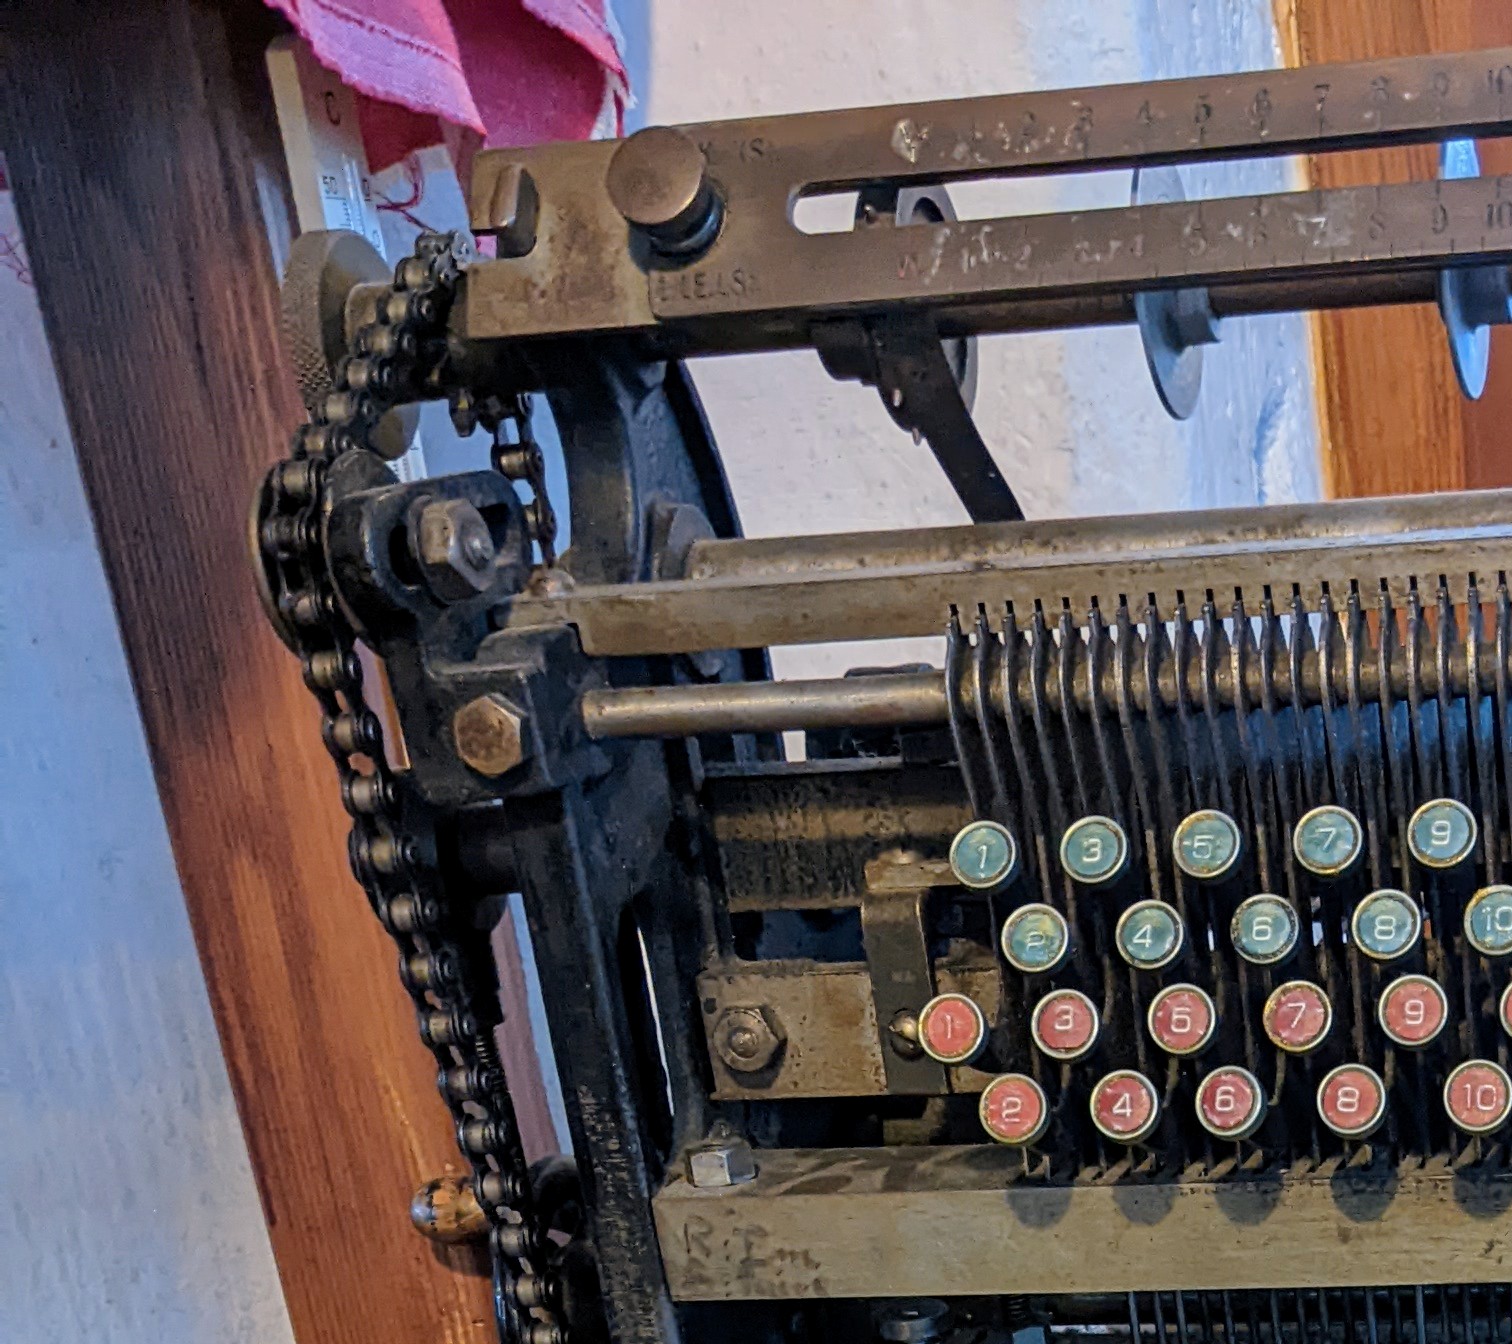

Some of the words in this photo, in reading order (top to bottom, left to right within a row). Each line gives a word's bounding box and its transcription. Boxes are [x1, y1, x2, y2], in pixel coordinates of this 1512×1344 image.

[976, 844, 988, 869] 1
[1082, 838, 1101, 863] 3
[1317, 827, 1337, 850] 7
[1431, 819, 1450, 846] 9
[1133, 923, 1152, 948] 4
[1251, 916, 1273, 942] 6
[1373, 915, 1397, 941] 8
[944, 1014, 953, 1039] 1
[1054, 1005, 1075, 1031] 3
[1287, 1002, 1307, 1029] 7
[1403, 999, 1425, 1025] 9
[1002, 1096, 1022, 1122] 2
[1112, 1092, 1133, 1117] 4
[1214, 1086, 1235, 1112] 6
[1336, 1086, 1360, 1112] 8
[1462, 1082, 1497, 1111] 10
